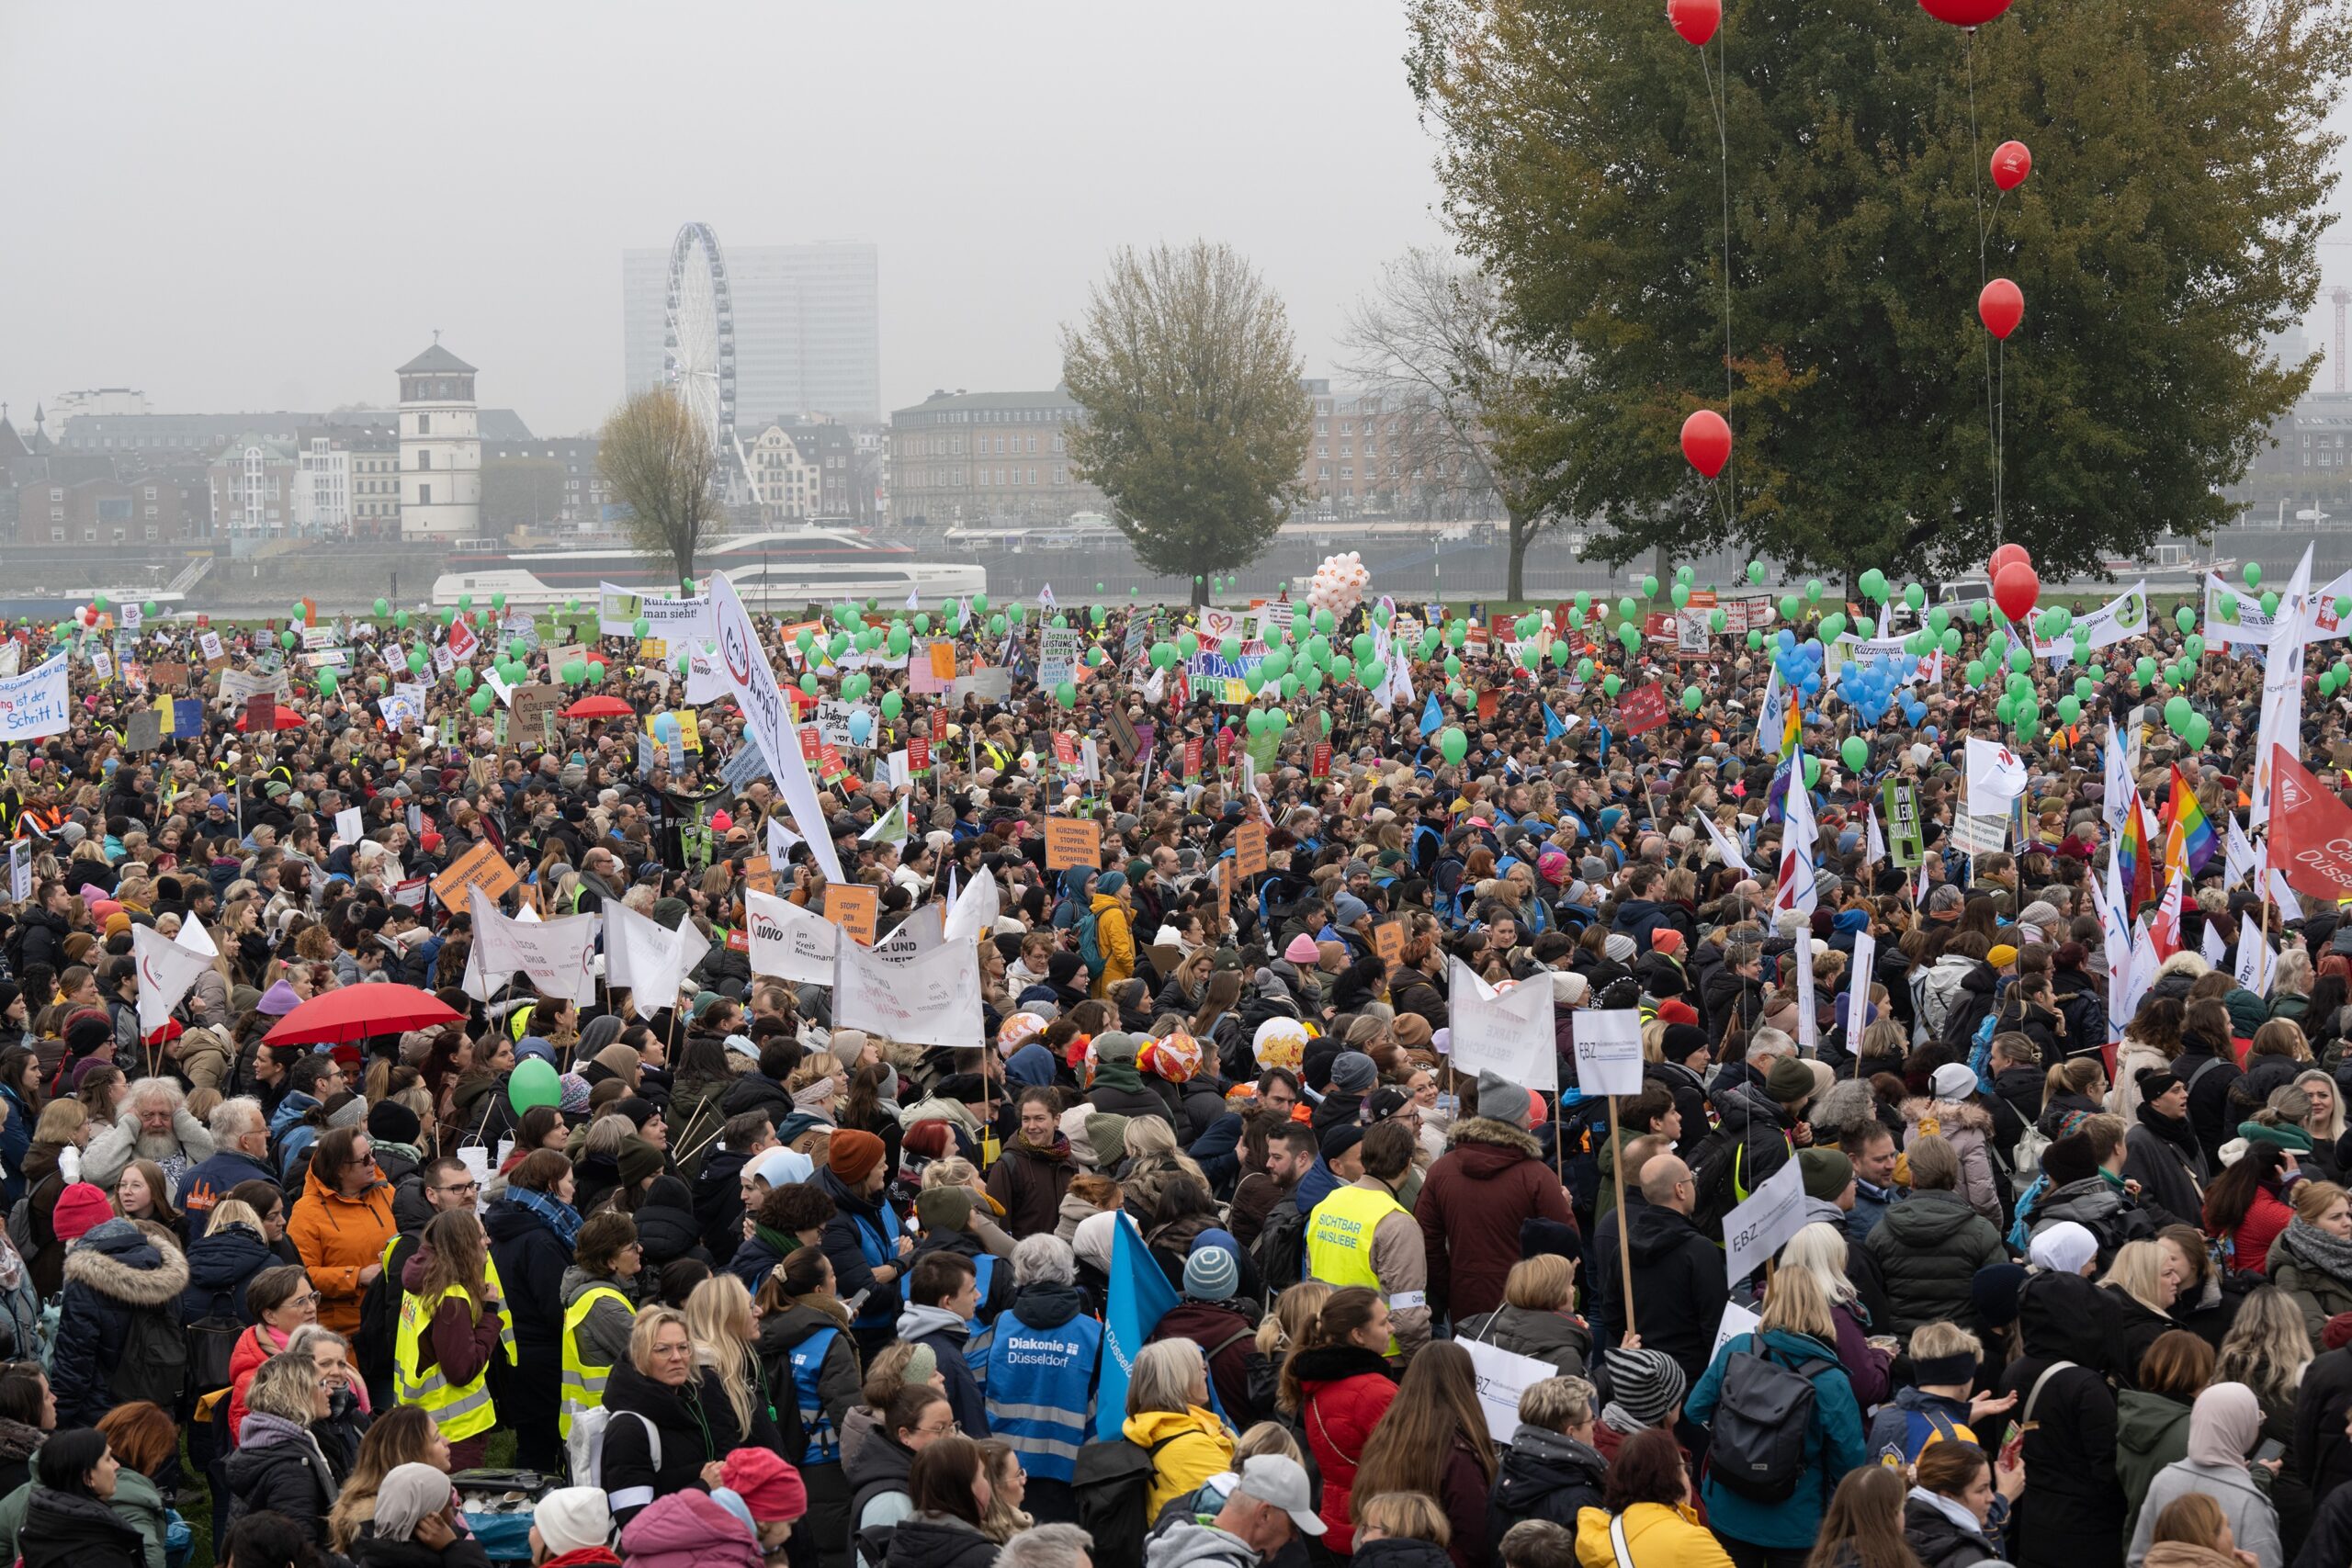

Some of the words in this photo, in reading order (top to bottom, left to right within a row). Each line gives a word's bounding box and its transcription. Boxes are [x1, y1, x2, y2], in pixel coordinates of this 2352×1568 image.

[644, 610, 667, 618] man
[670, 608, 697, 618] sieht!
[1047, 632, 1079, 640] SOZIALE
[692, 663, 712, 676] AWO
[17, 693, 28, 706] ist
[30, 691, 47, 703] der
[7, 705, 51, 729] Schritt
[1893, 785, 1912, 804] NRW
[1894, 802, 1915, 821] BLEIB
[1056, 826, 1090, 836] KÜRZUNGEN
[1889, 819, 1918, 840] SOZIAL!
[1054, 845, 1093, 855] PERSPEKTIVEN
[1058, 854, 1090, 863] SCHAFFEN!
[440, 849, 497, 898] MENSCHENRECHTE
[840, 901, 860, 910] STOPPT
[842, 913, 855, 922] DEN
[756, 924, 784, 942] AWO
[797, 931, 808, 939] im
[795, 942, 817, 951] Kreis
[891, 942, 917, 953] UND
[1317, 1213, 1362, 1235] SICHTBAR
[1009, 1337, 1065, 1353] Diakonie
[1007, 1352, 1069, 1368] Düsseldorf
[1475, 1374, 1488, 1396] BZ
